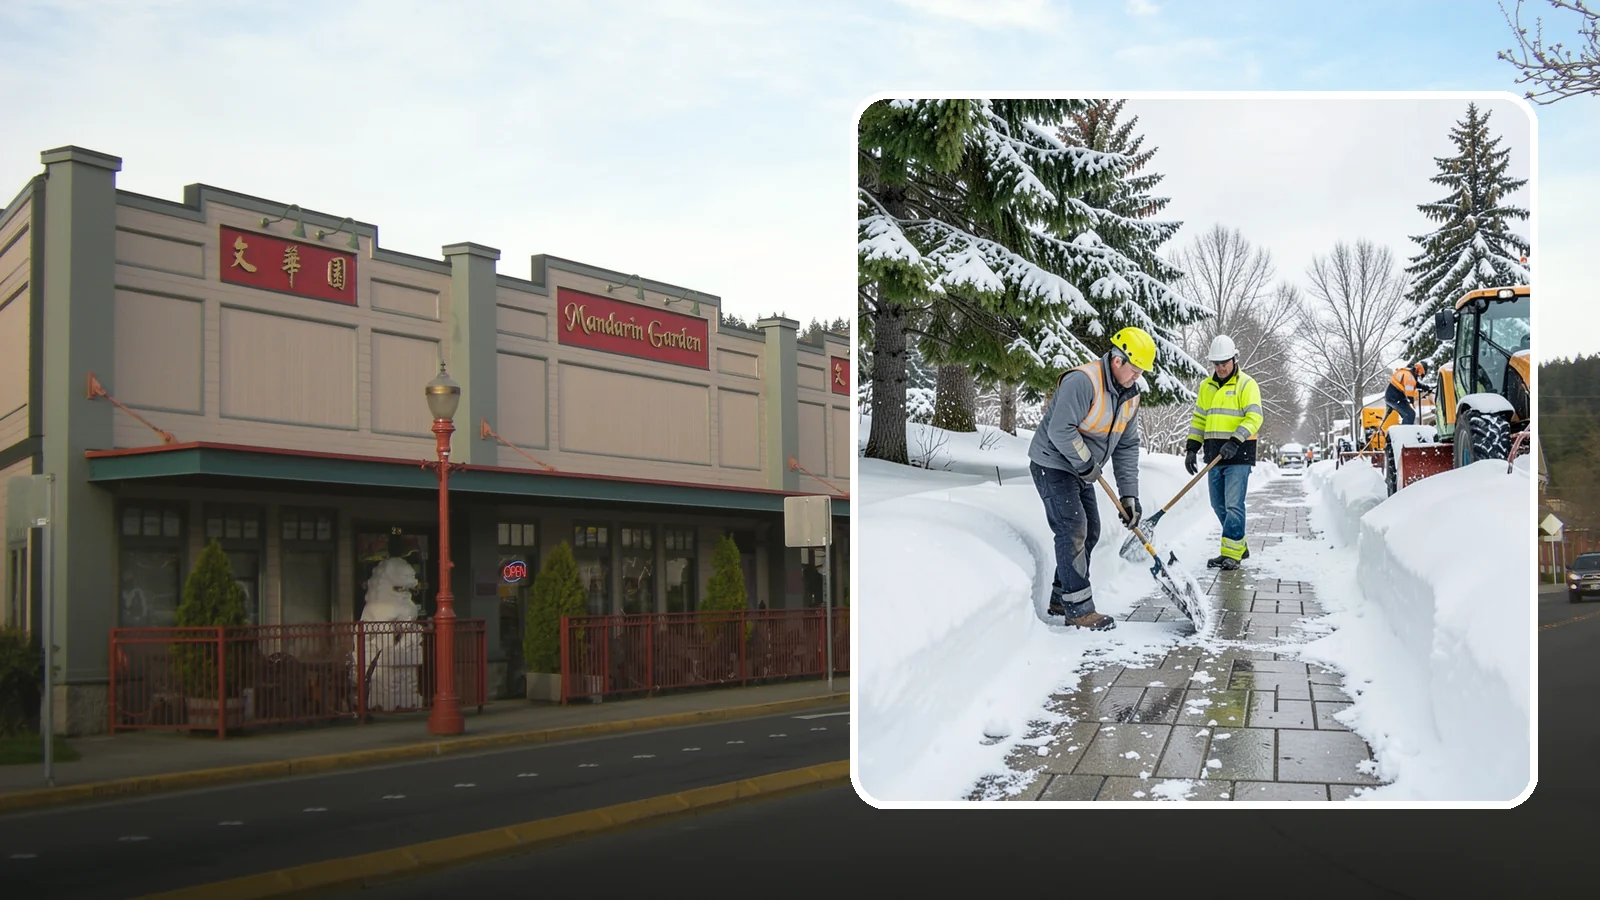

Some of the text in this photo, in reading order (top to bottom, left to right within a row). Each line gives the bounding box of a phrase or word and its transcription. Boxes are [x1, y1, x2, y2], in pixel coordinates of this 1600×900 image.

[230, 235, 346, 291] 文華園
[564, 302, 701, 352] Mandarin Garden
[503, 565, 527, 578] OPEN
